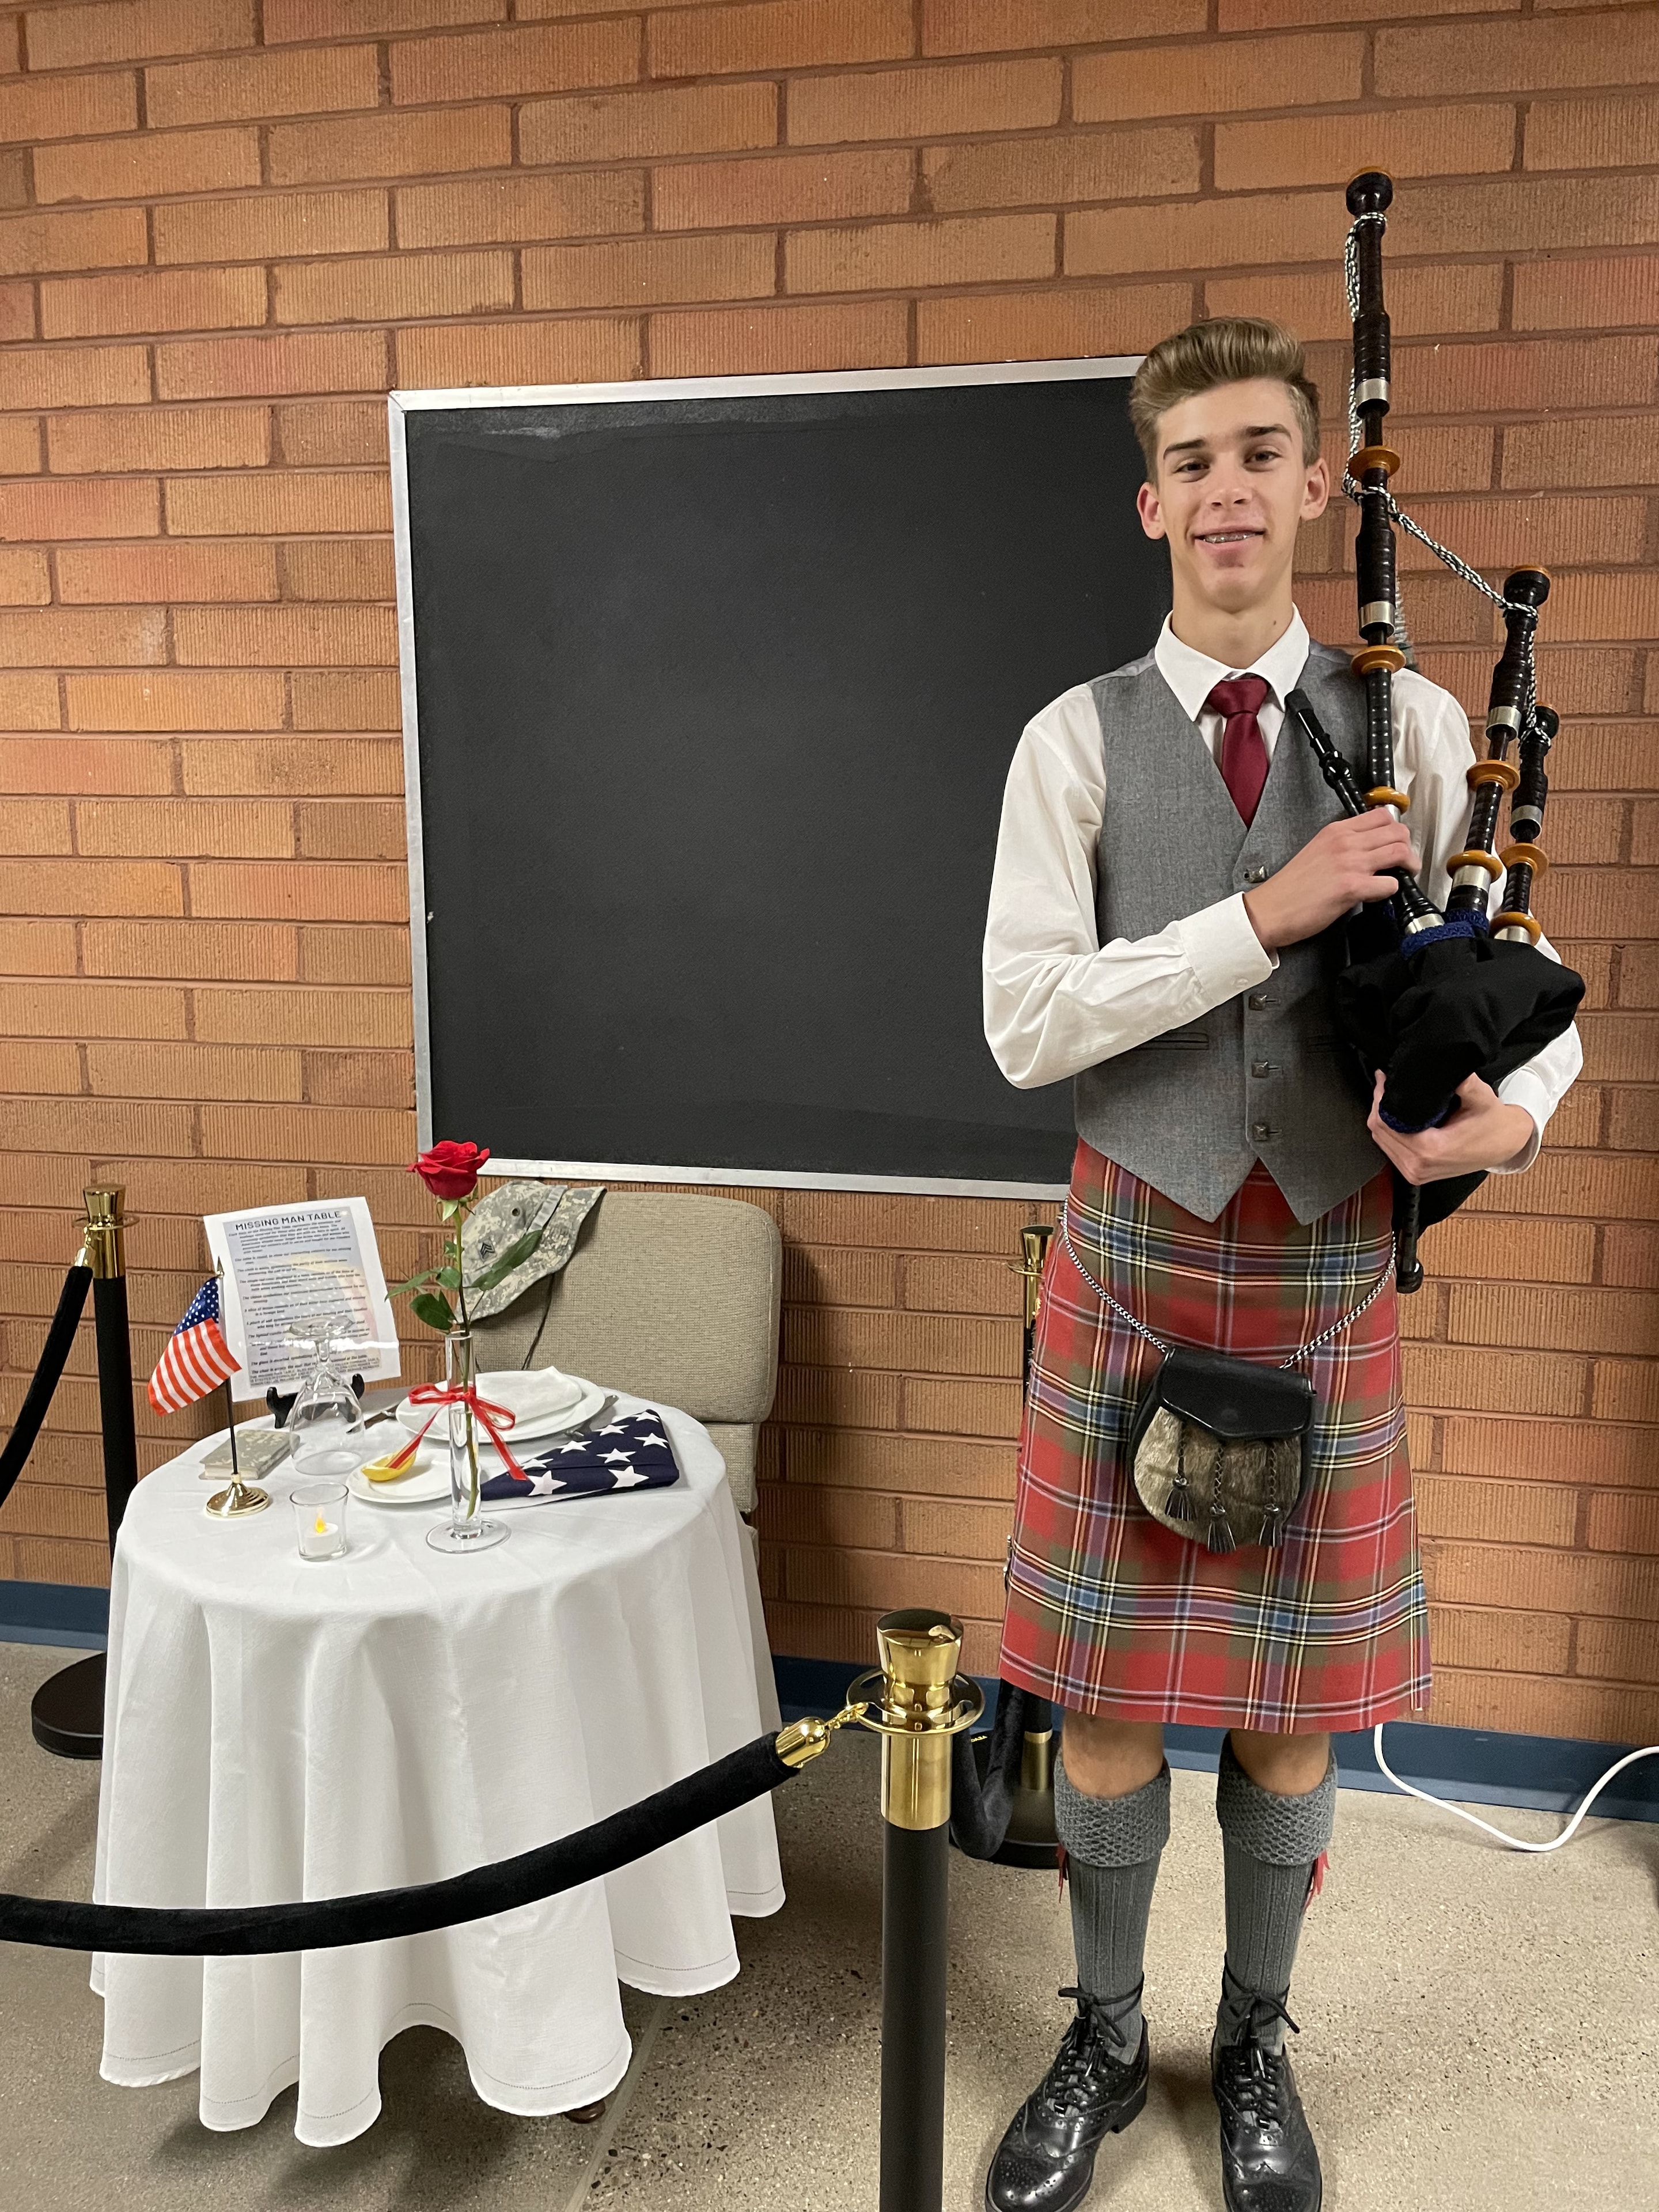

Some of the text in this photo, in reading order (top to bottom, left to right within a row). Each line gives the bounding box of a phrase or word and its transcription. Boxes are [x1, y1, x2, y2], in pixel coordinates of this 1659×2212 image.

[236, 1211, 341, 1230] MISSING MAN TABLE
